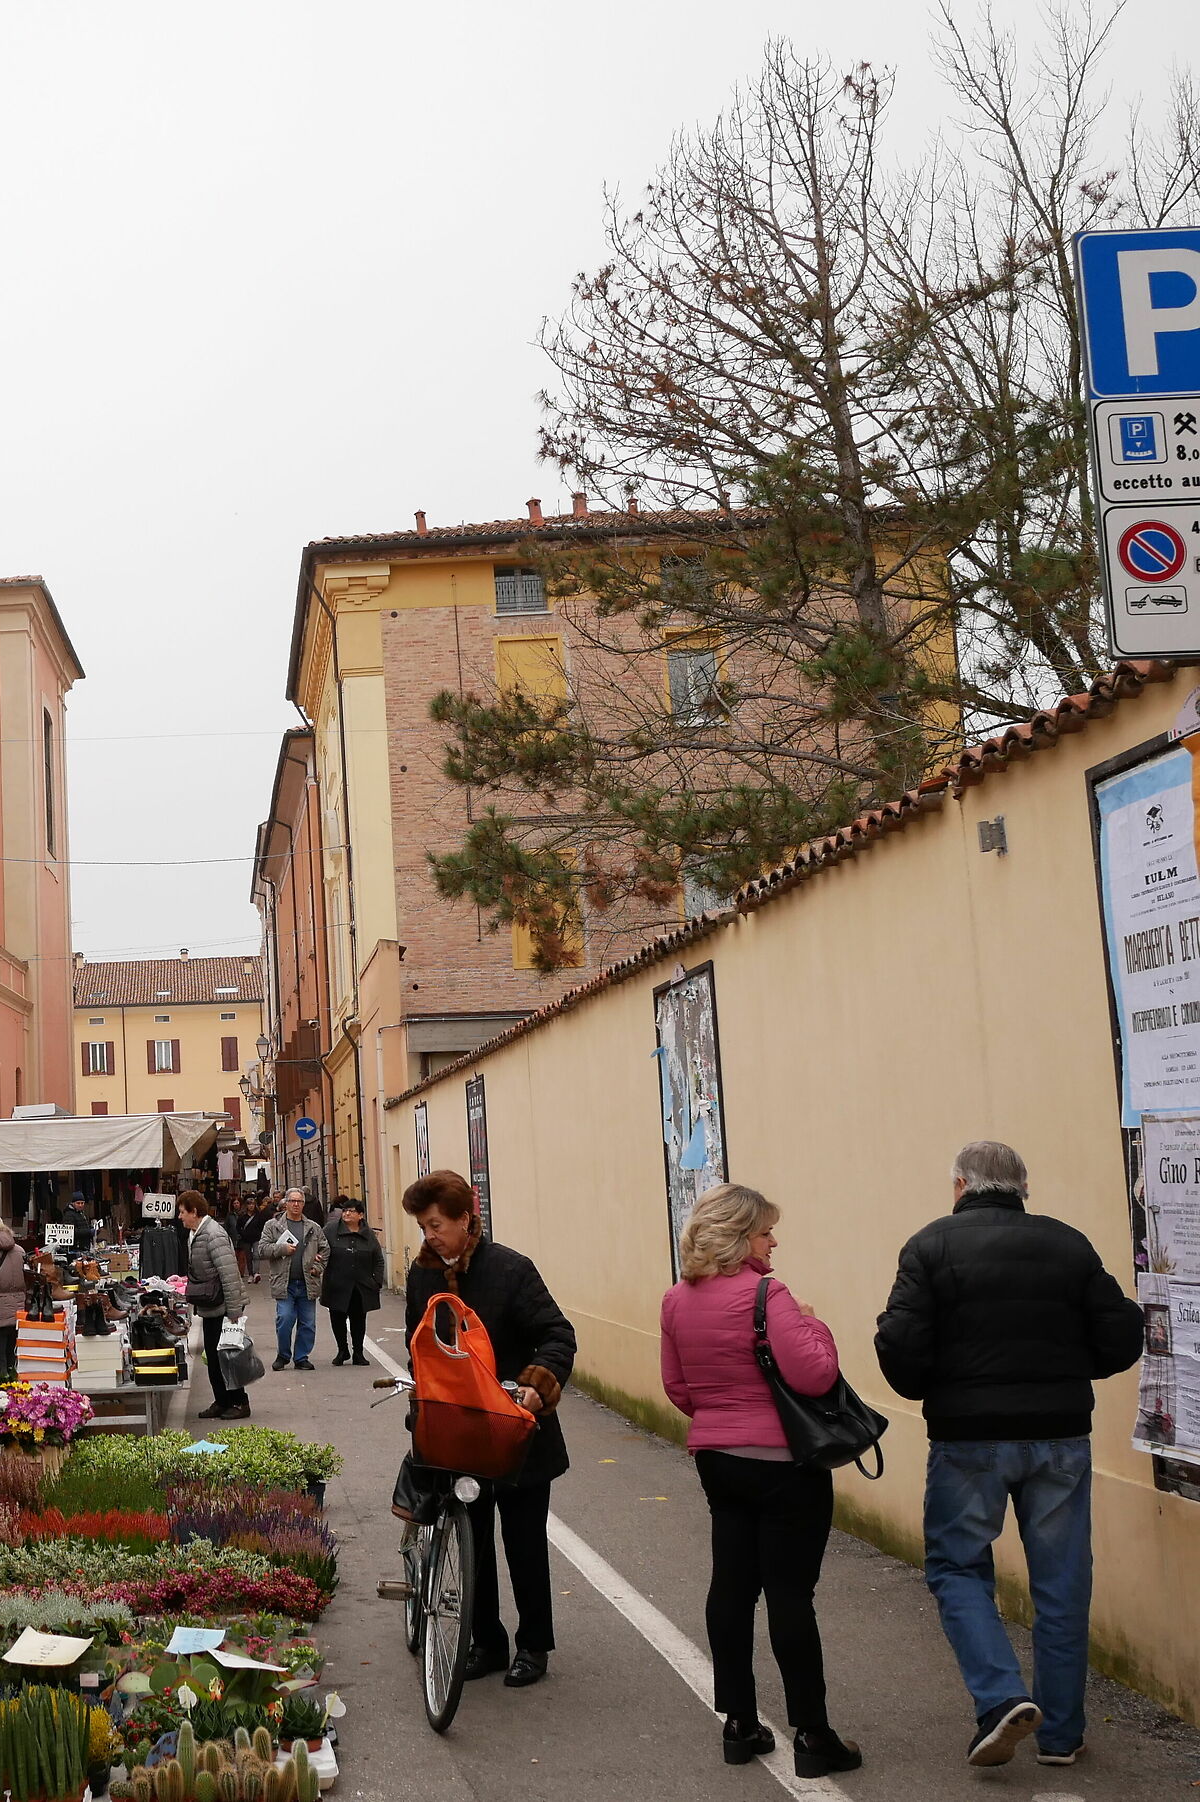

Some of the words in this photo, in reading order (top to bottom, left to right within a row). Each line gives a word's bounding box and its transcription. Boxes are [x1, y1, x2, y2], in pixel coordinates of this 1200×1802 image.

[1116, 247, 1200, 378] P
[1131, 423, 1143, 437] P
[1113, 474, 1173, 490] eccetto
[1144, 866, 1178, 886] IULM
[1124, 924, 1175, 974] MARGHERITA
[1159, 1156, 1187, 1184] Gino
[145, 1200, 171, 1213] €5,00
